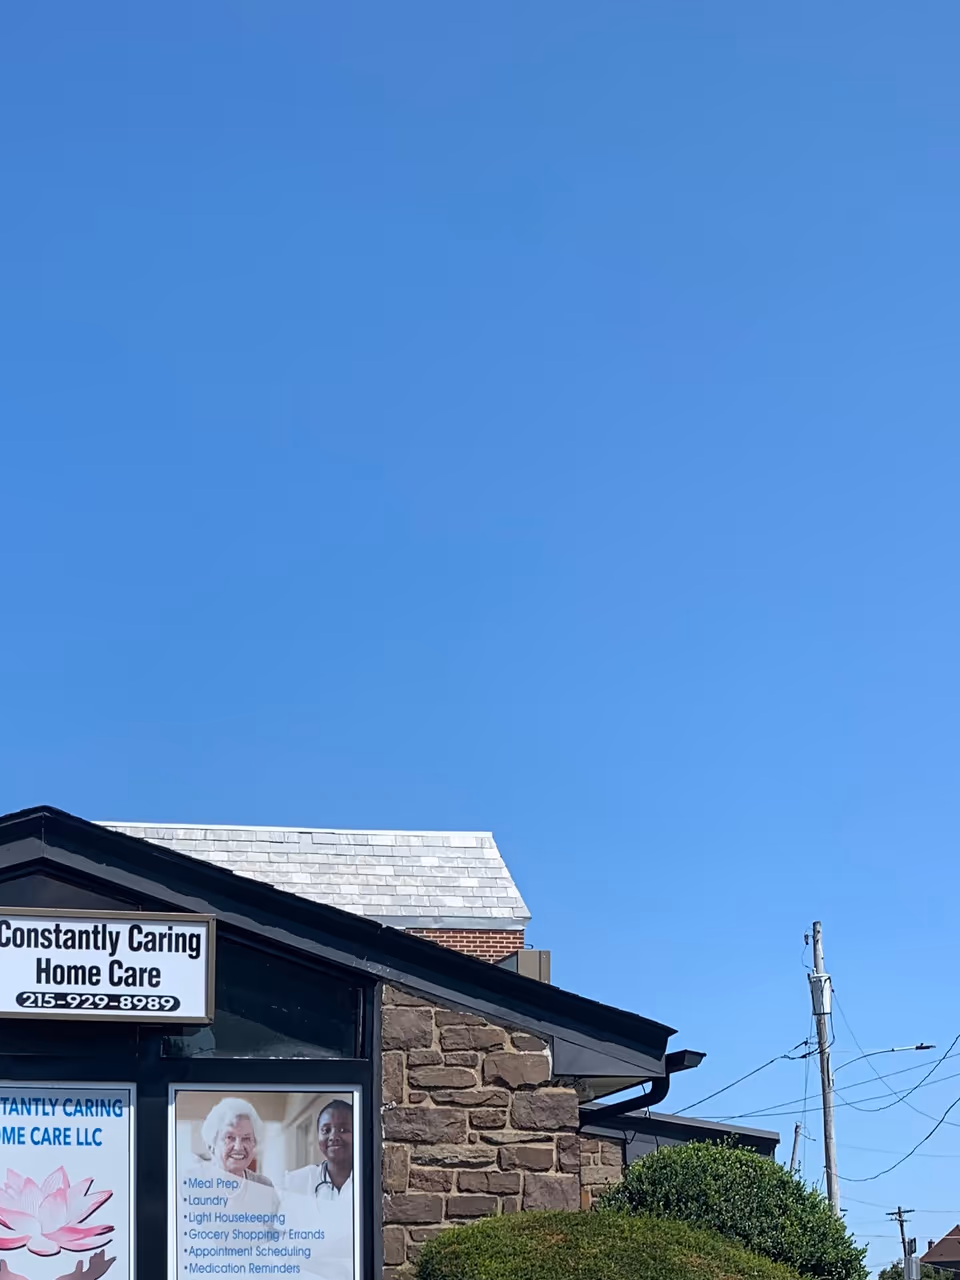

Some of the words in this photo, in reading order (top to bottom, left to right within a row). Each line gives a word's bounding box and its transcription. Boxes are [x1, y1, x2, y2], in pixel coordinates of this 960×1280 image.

[128, 924, 201, 959] Caring
[36, 958, 101, 986] Home
[109, 959, 161, 987] Care
[22, 993, 174, 1011] 215-929-8989
[63, 1098, 123, 1117] CARING
[31, 1127, 71, 1145] CARE
[77, 1128, 102, 1146] LLC
[188, 1178, 213, 1188] Meal
[188, 1195, 228, 1207] Laundry
[188, 1212, 211, 1224] Light
[215, 1213, 285, 1225] Housekeeping
[189, 1229, 229, 1241] Grocery
[233, 1229, 279, 1242] Shopping
[289, 1229, 325, 1239] Errands
[189, 1246, 252, 1258] Appointment
[256, 1246, 311, 1259] Scheduling
[189, 1263, 245, 1274] Medication
[249, 1263, 300, 1274] Reminders
